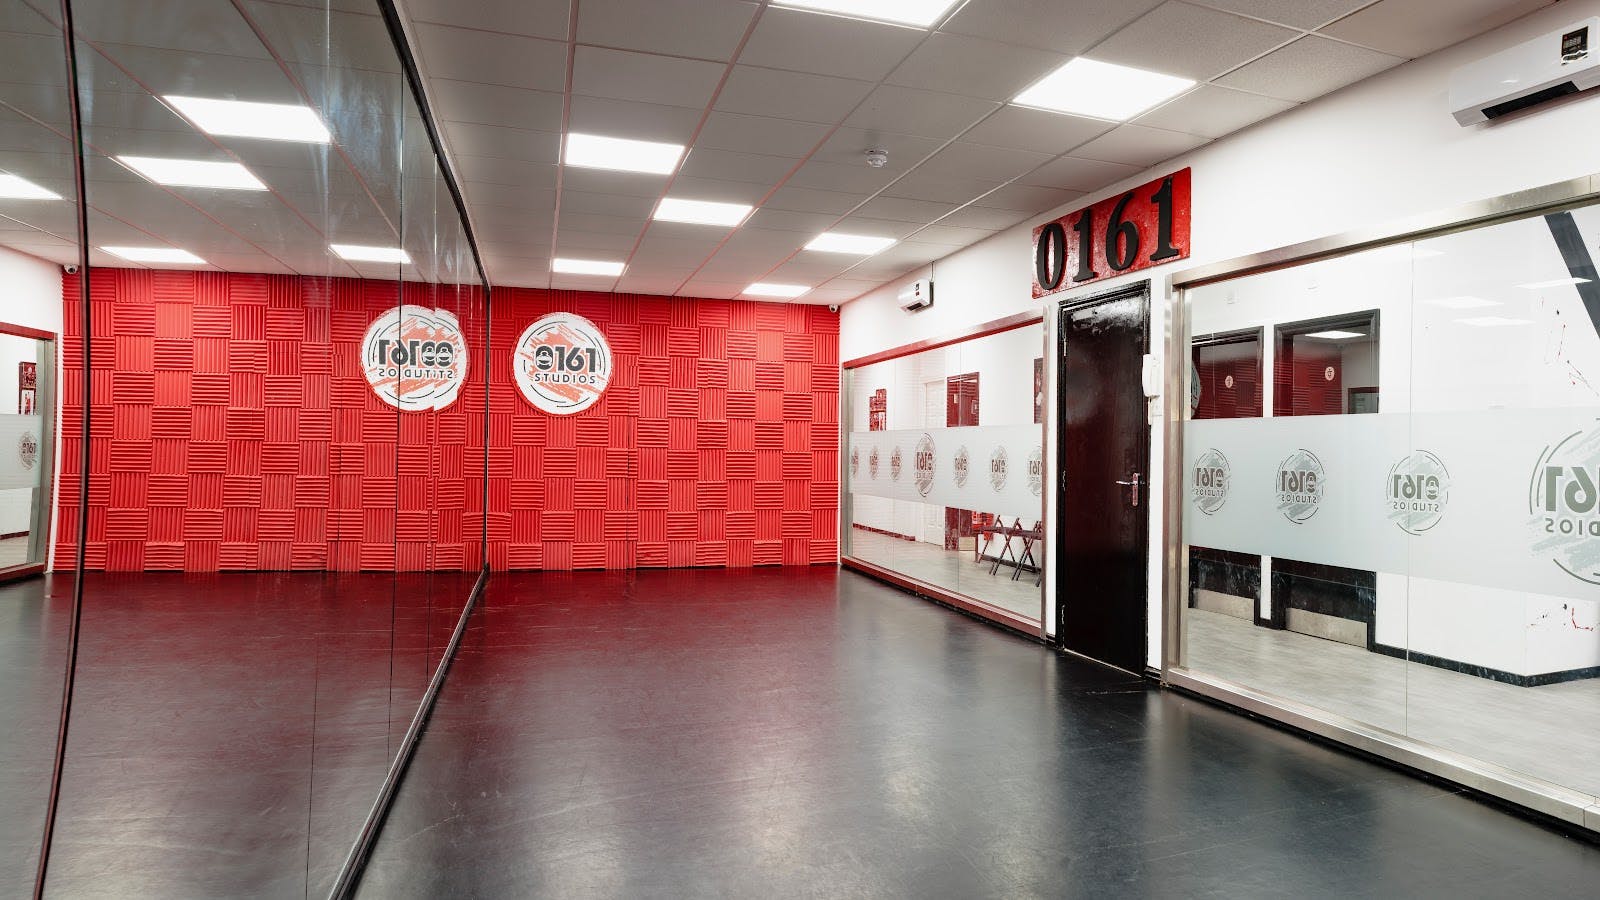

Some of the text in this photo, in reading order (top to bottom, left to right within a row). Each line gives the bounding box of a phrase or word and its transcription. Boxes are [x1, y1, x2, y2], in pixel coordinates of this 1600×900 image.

[1036, 175, 1180, 290] 0161
[535, 345, 596, 373] 0161
[534, 373, 596, 384] STUDIOS
